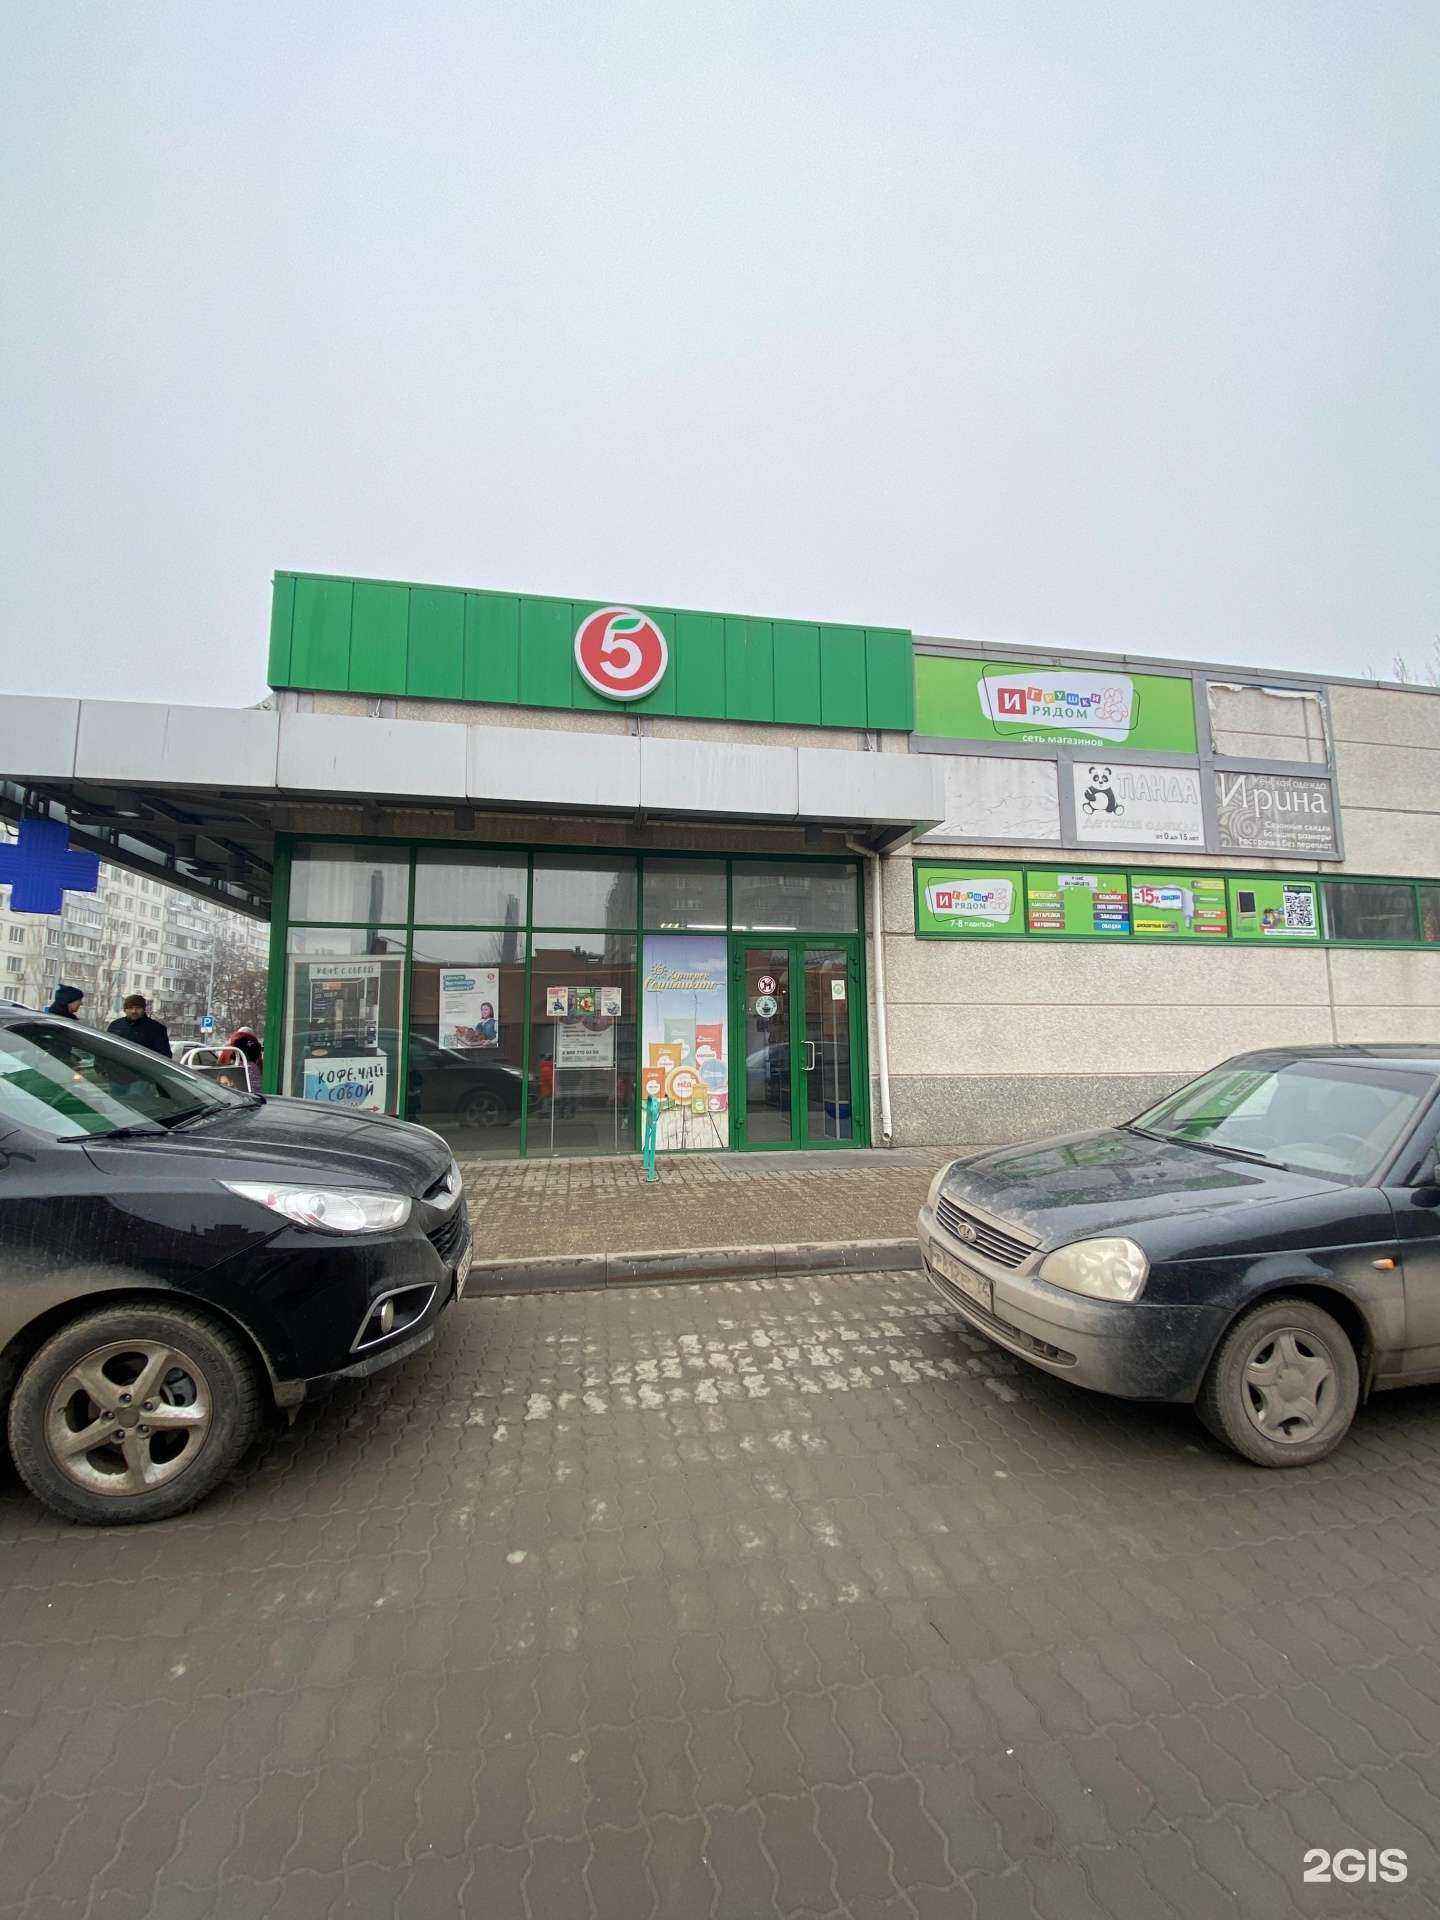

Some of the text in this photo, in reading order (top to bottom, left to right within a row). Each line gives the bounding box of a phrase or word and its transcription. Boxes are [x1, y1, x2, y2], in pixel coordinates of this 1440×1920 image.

[600, 614, 643, 679] 5
[1032, 706, 1088, 720] РЯДОМ
[1022, 733, 1104, 747] сеть магазинов
[1115, 774, 1199, 805] ПАНДА
[1217, 773, 1328, 818] Ирина
[328, 1081, 374, 1101] СОБОЙ
